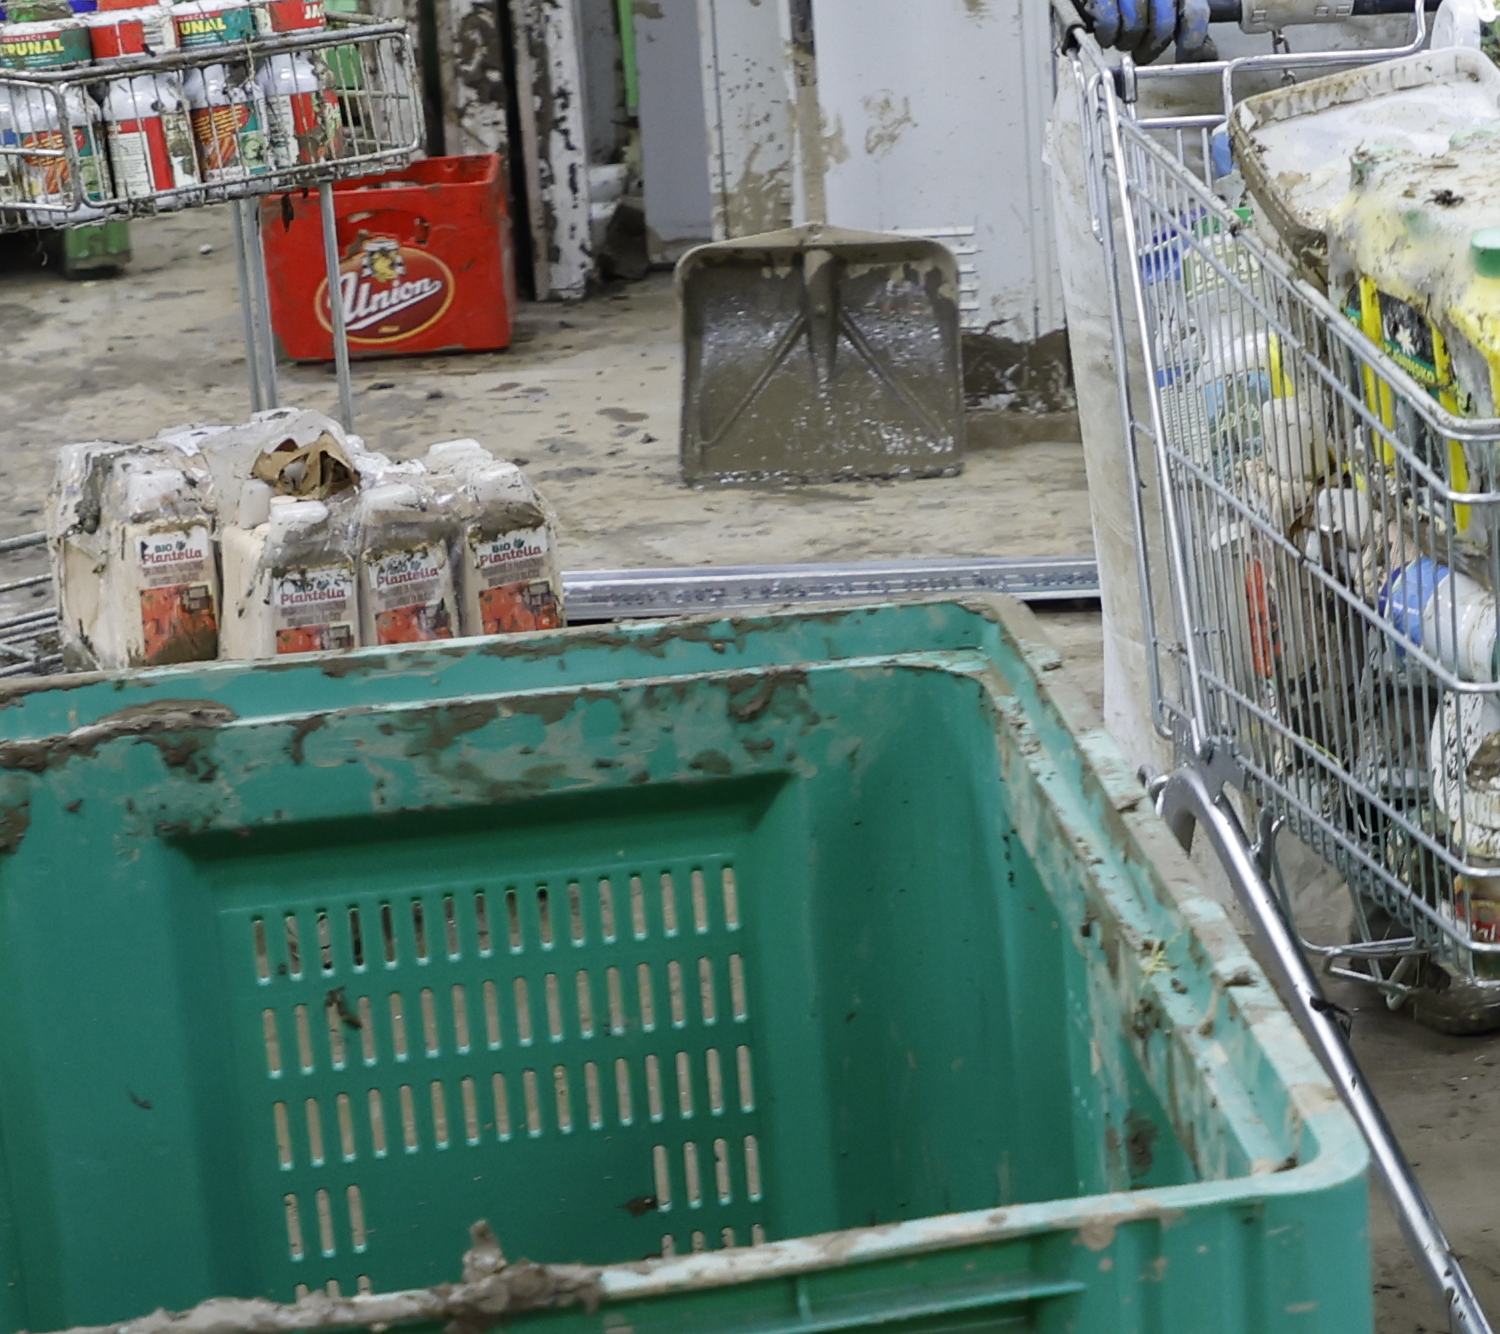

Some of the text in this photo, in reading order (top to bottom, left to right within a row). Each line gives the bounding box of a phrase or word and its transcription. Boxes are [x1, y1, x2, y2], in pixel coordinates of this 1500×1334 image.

[328, 271, 440, 327] Union
[154, 543, 173, 553] BIO
[491, 542, 511, 553] BIO
[143, 548, 203, 564] Plantella
[479, 545, 542, 567] Plantella
[377, 567, 439, 587] Plantella
[281, 588, 346, 604] Plantella
